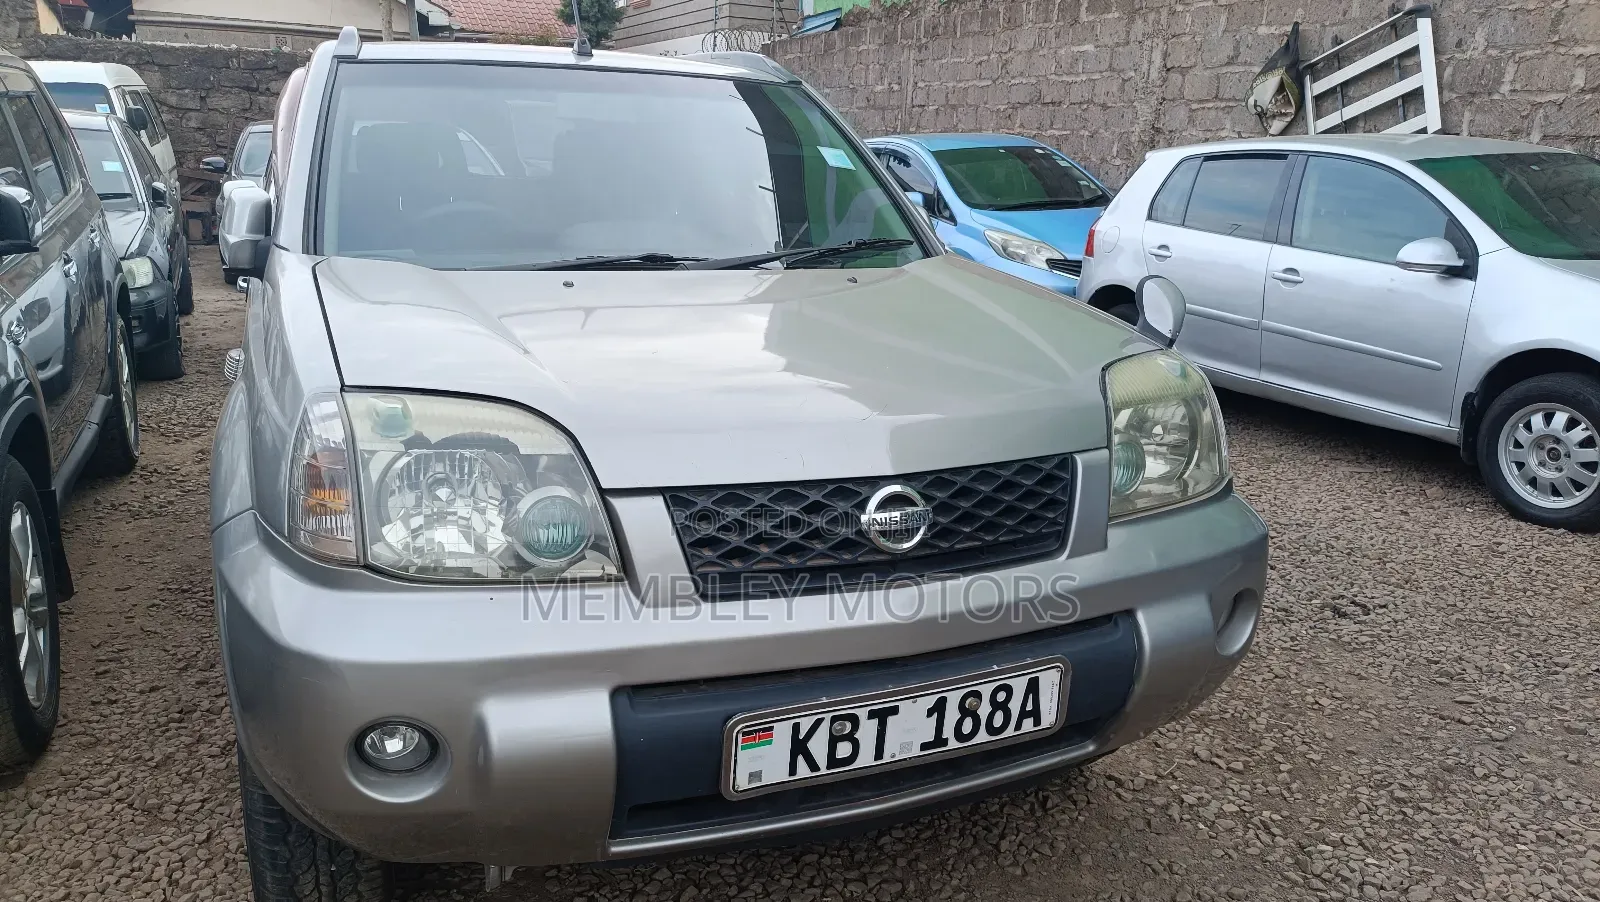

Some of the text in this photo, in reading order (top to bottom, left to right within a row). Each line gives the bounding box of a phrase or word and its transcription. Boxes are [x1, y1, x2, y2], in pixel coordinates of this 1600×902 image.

[872, 509, 929, 528] NISSAN
[788, 704, 900, 777] KBT
[919, 675, 1042, 752] 188A
